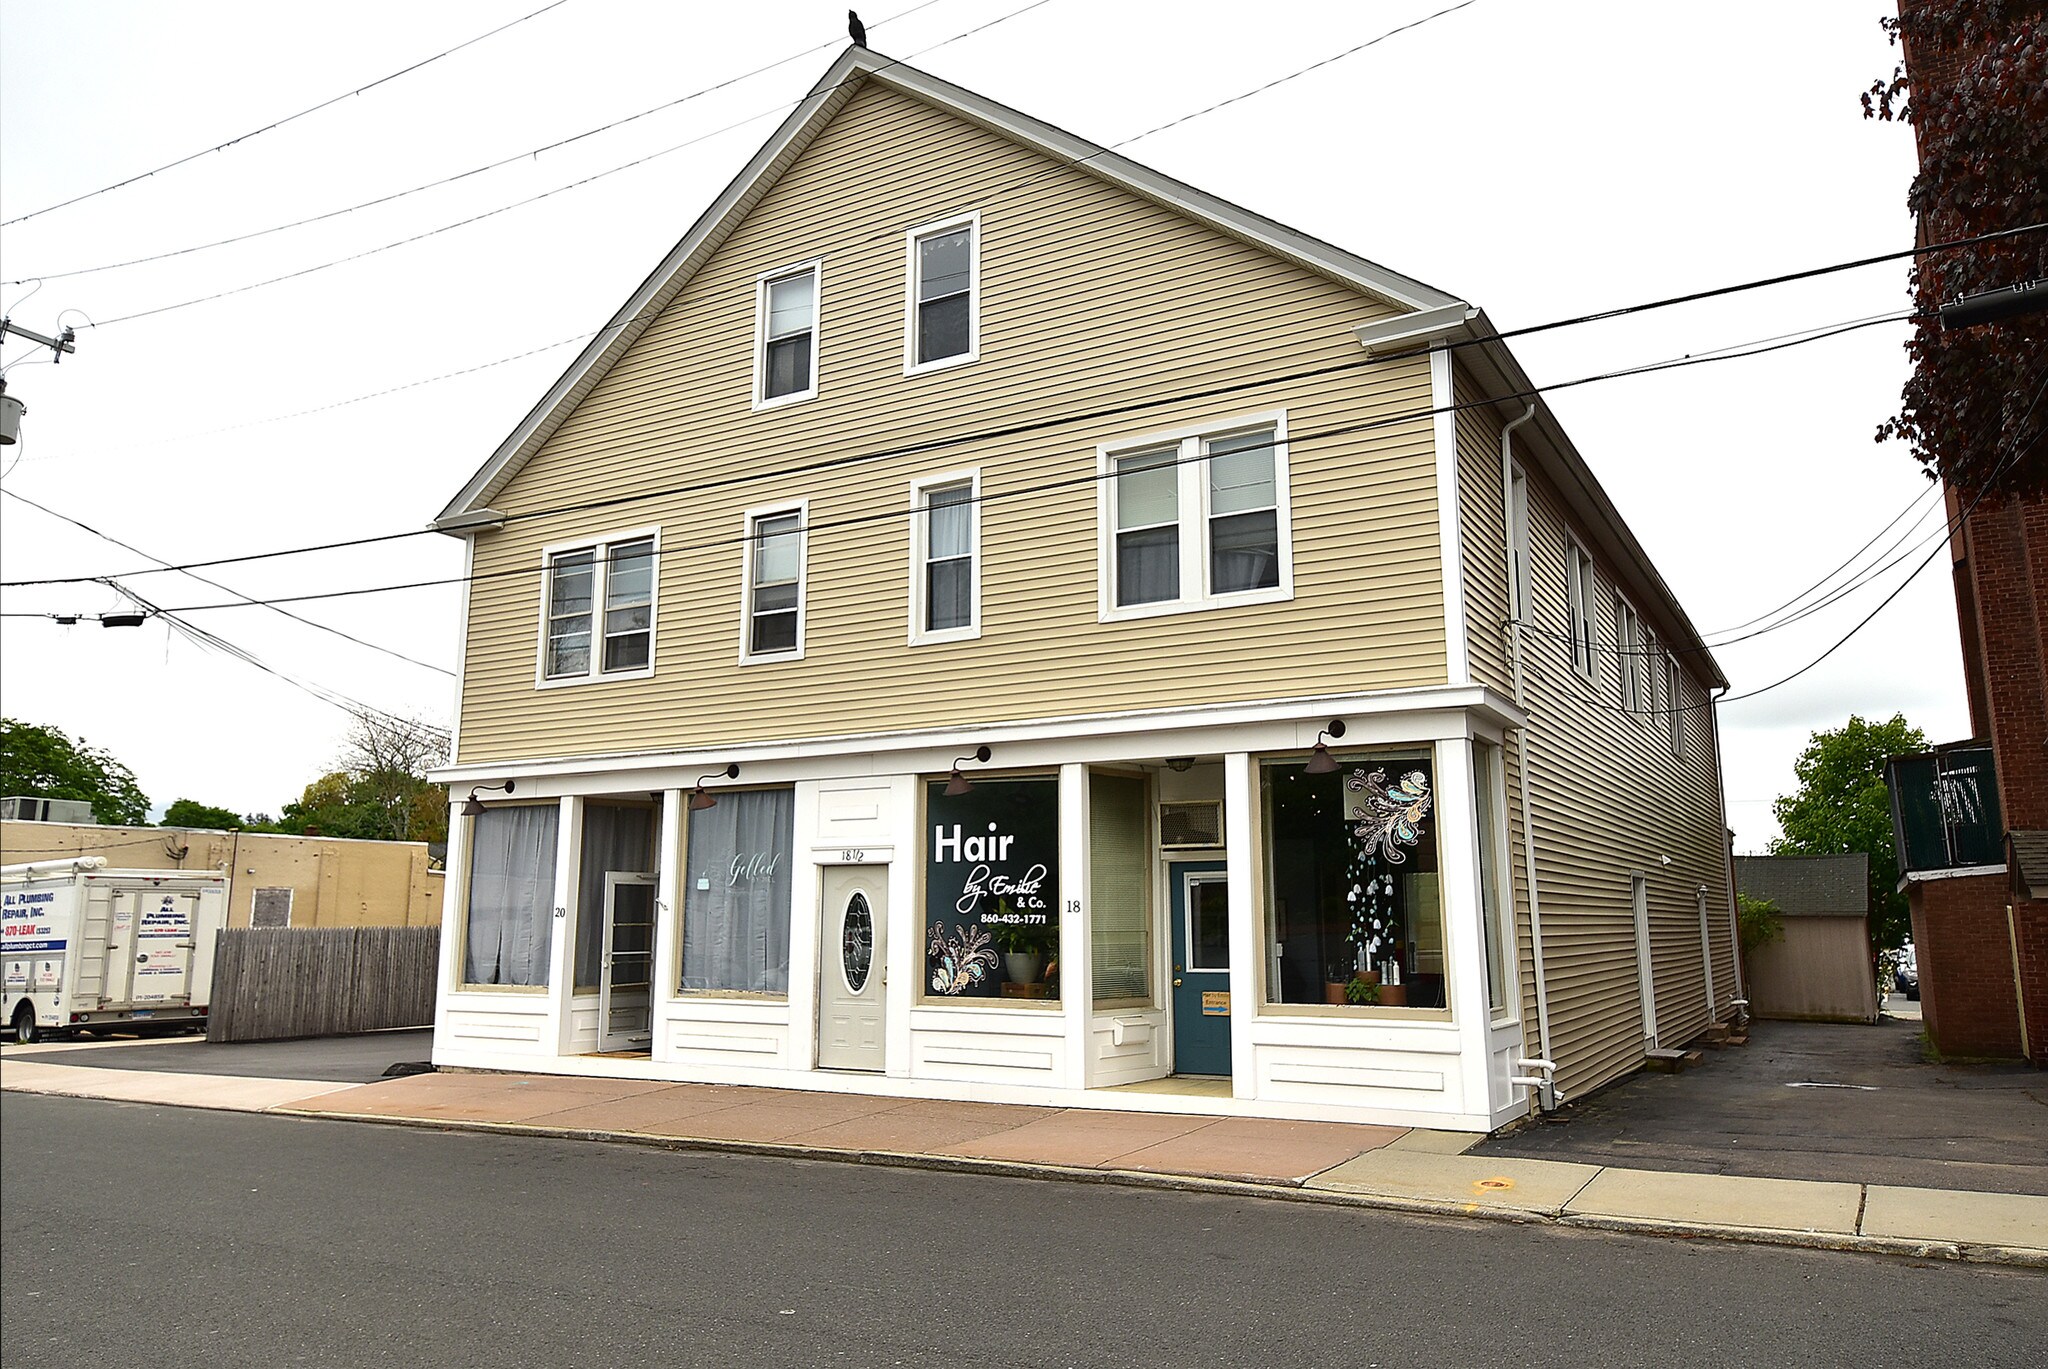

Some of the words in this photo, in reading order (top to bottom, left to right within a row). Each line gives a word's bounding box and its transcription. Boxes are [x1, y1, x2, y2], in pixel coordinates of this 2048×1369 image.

[935, 822, 1014, 863] Hair
[729, 852, 781, 887] Gelled
[956, 864, 990, 914] by
[989, 864, 1048, 895] Emilie
[18, 893, 54, 904] PLUMBING
[1017, 897, 1026, 908] &
[1028, 897, 1047, 908] Co.
[555, 907, 566, 918] 20
[1067, 900, 1081, 913] 18
[980, 914, 1047, 924] 860-432-1771
